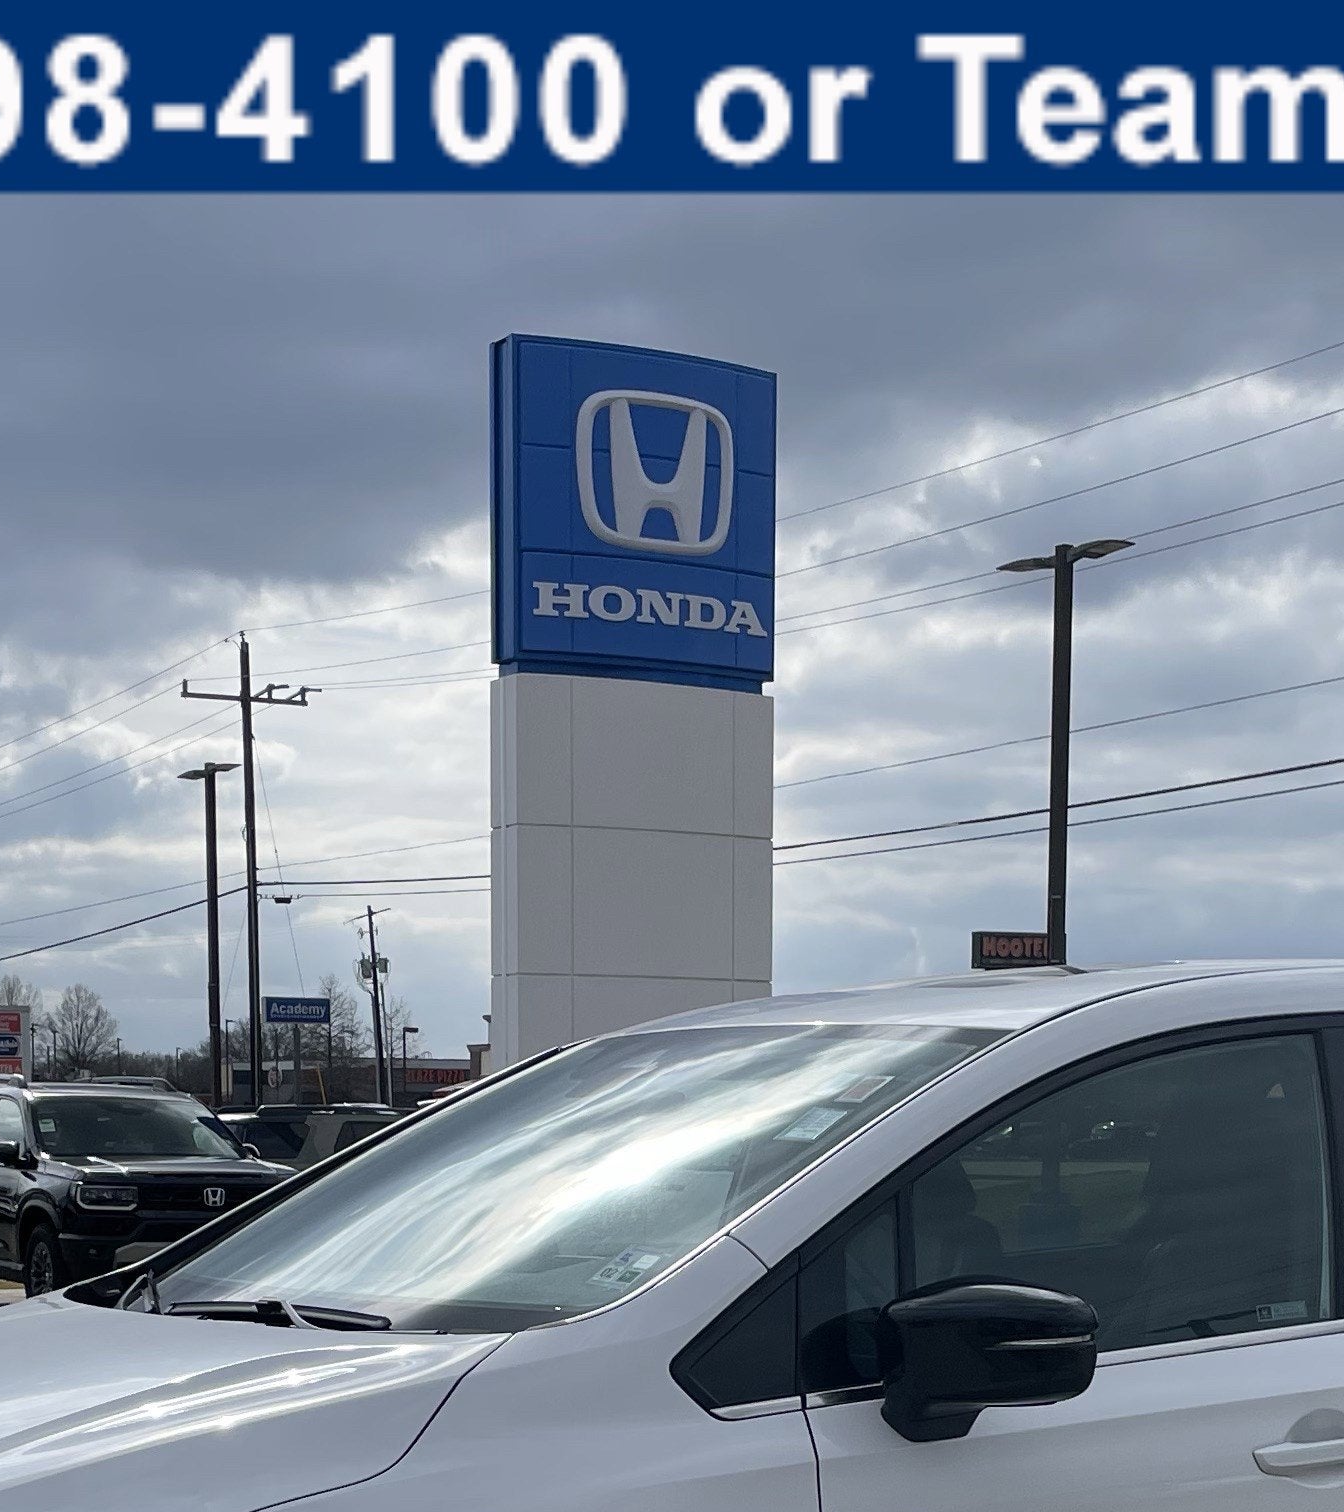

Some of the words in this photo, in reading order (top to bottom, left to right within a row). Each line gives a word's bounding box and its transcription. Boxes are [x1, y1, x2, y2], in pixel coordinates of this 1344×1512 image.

[532, 580, 768, 637] HONDA
[981, 936, 1048, 958] HOOTE
[271, 1002, 326, 1018] Academy
